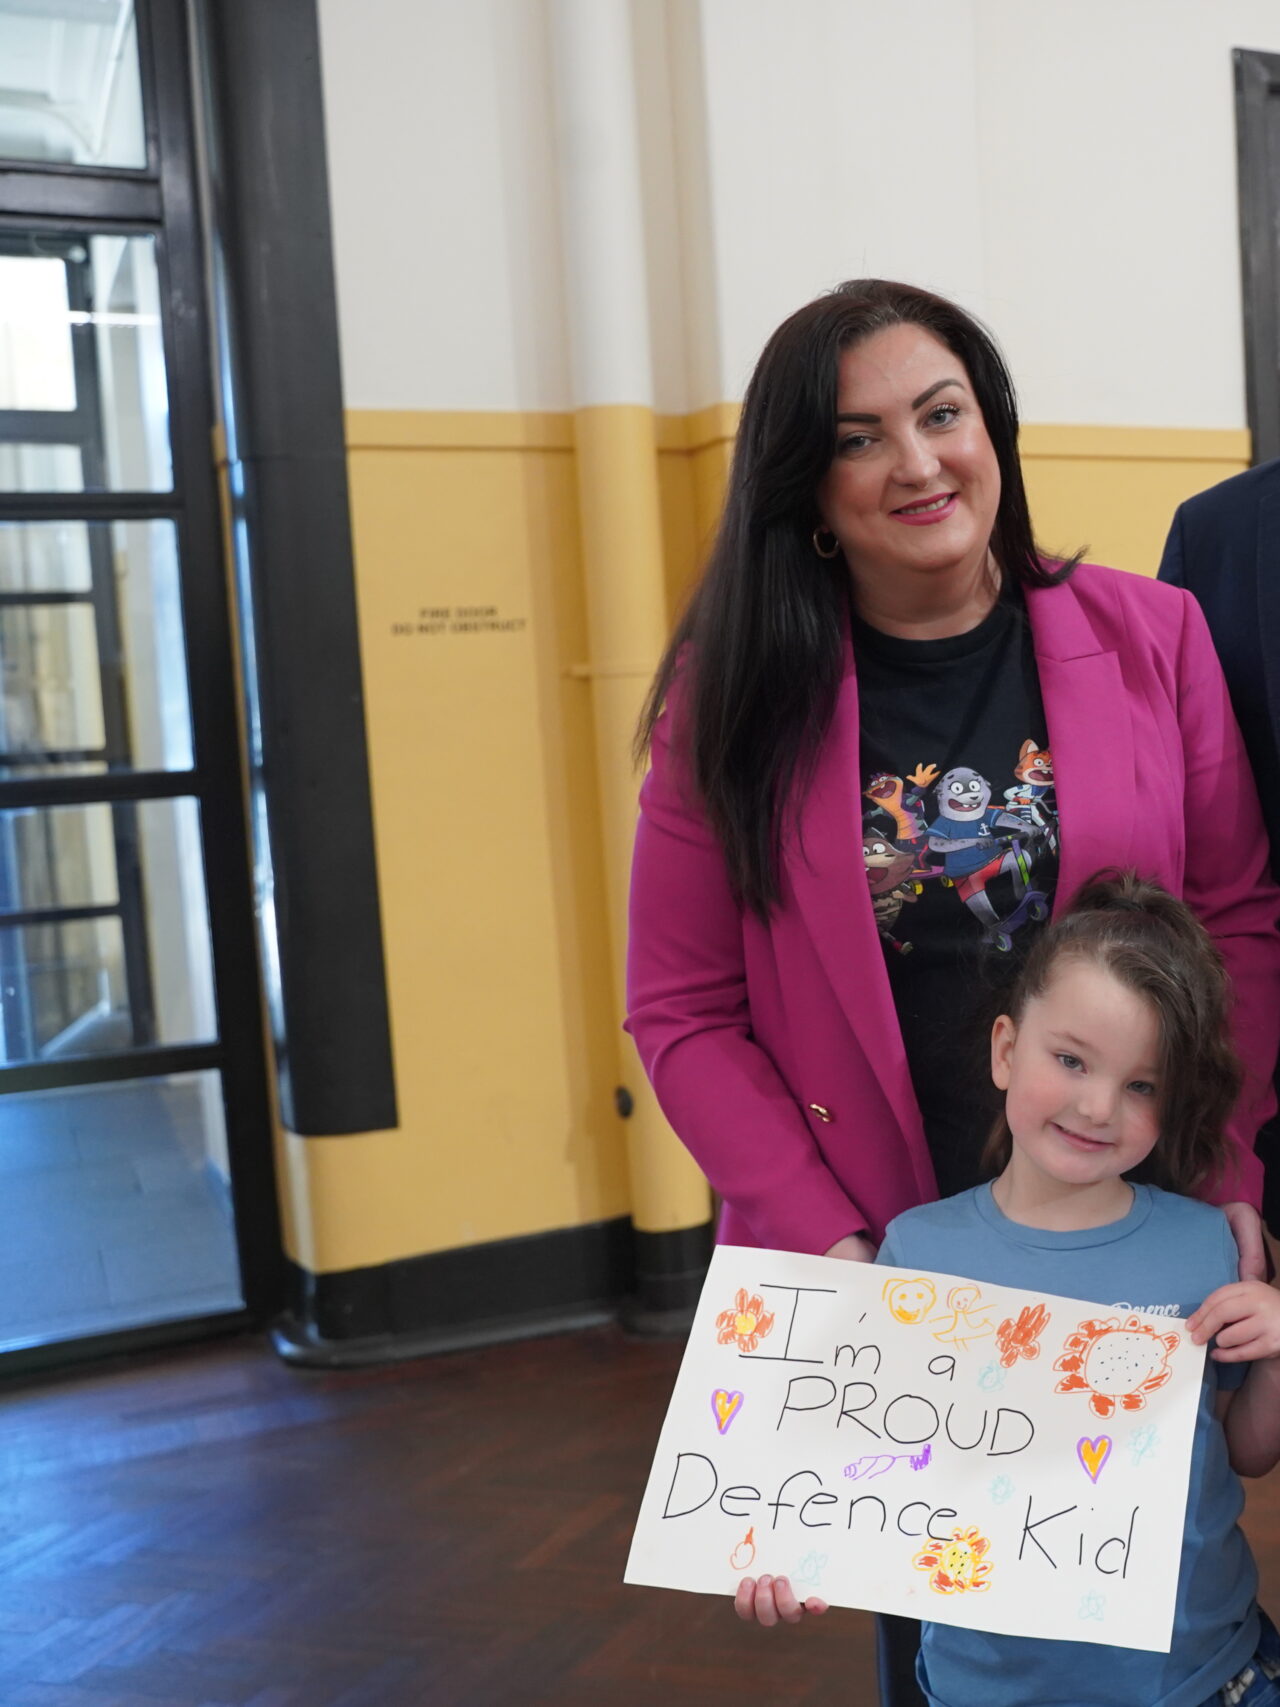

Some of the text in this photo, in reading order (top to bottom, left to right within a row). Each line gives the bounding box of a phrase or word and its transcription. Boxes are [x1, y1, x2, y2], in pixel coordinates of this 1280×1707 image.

[738, 1284, 957, 1382] I'm a
[776, 1375, 1035, 1457] PROUD
[662, 1452, 1140, 1580] Defence Kid
